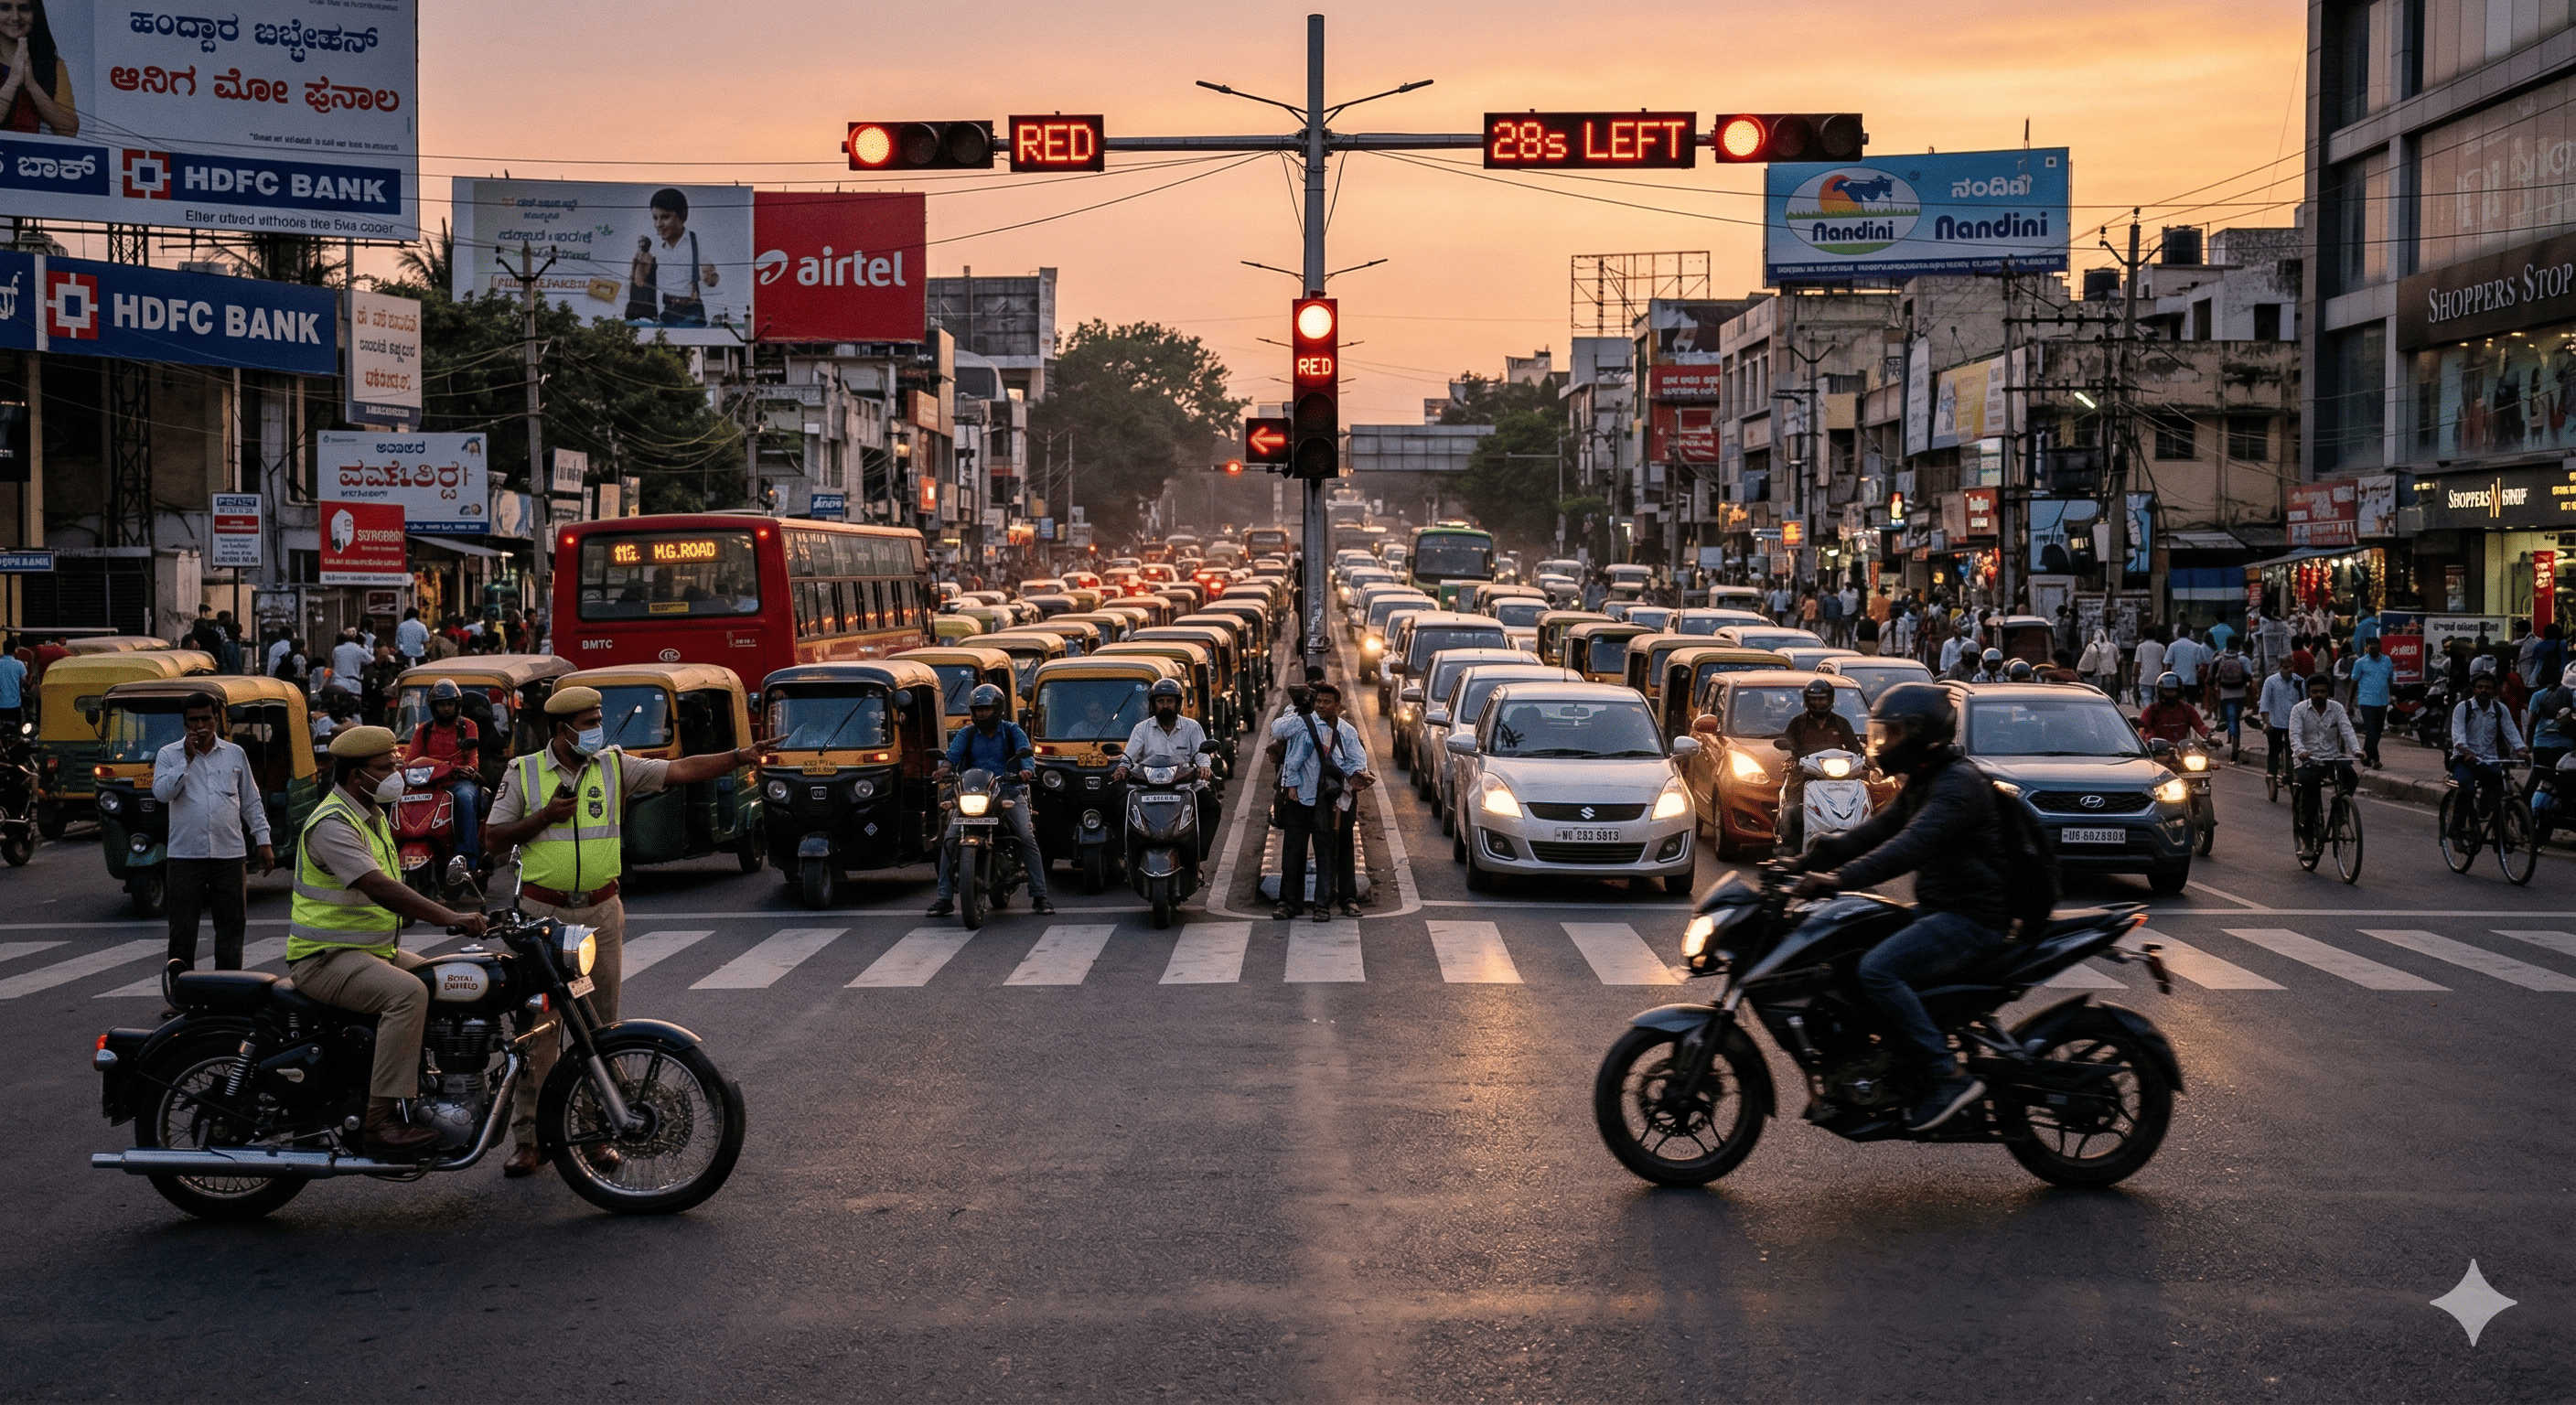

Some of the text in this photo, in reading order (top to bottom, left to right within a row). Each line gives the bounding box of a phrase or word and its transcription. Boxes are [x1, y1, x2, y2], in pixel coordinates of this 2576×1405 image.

[1018, 124, 1094, 161] RED
[1493, 121, 1686, 159] 28s LEFT
[185, 166, 387, 203] HDFC BANK
[797, 246, 907, 287] airtel
[2428, 263, 2573, 324] SHOPPERS STOP
[113, 293, 214, 336] HDFC
[225, 304, 321, 345] BANK
[1298, 358, 1333, 375] RED
[582, 639, 614, 650] BMTC
